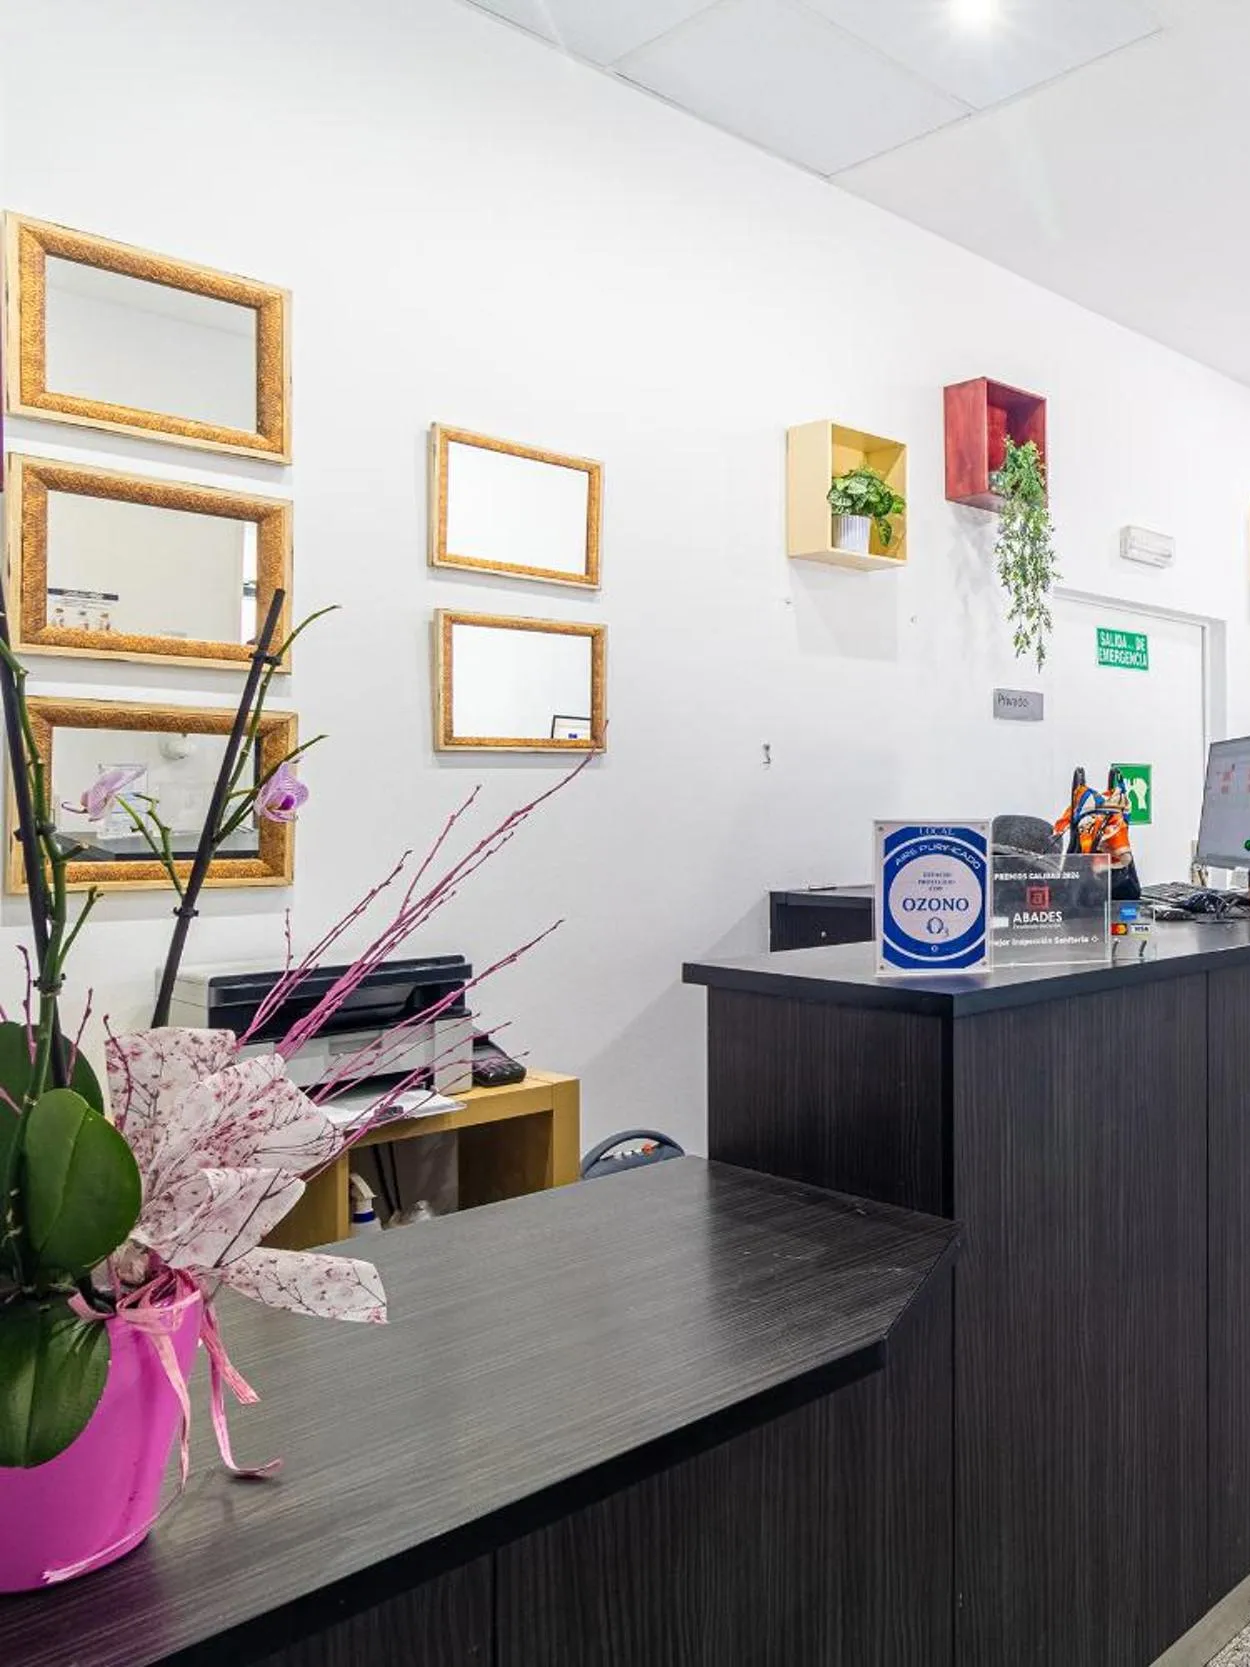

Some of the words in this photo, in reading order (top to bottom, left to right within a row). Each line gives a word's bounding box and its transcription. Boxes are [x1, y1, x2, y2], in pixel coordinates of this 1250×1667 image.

[1100, 631, 1127, 648] SALIDA
[1135, 635, 1147, 651] DE
[1099, 648, 1147, 667] EMERGENCIA
[902, 897, 969, 912] OZONO
[1013, 911, 1063, 923] ABADES
[991, 938, 1010, 947] ejor
